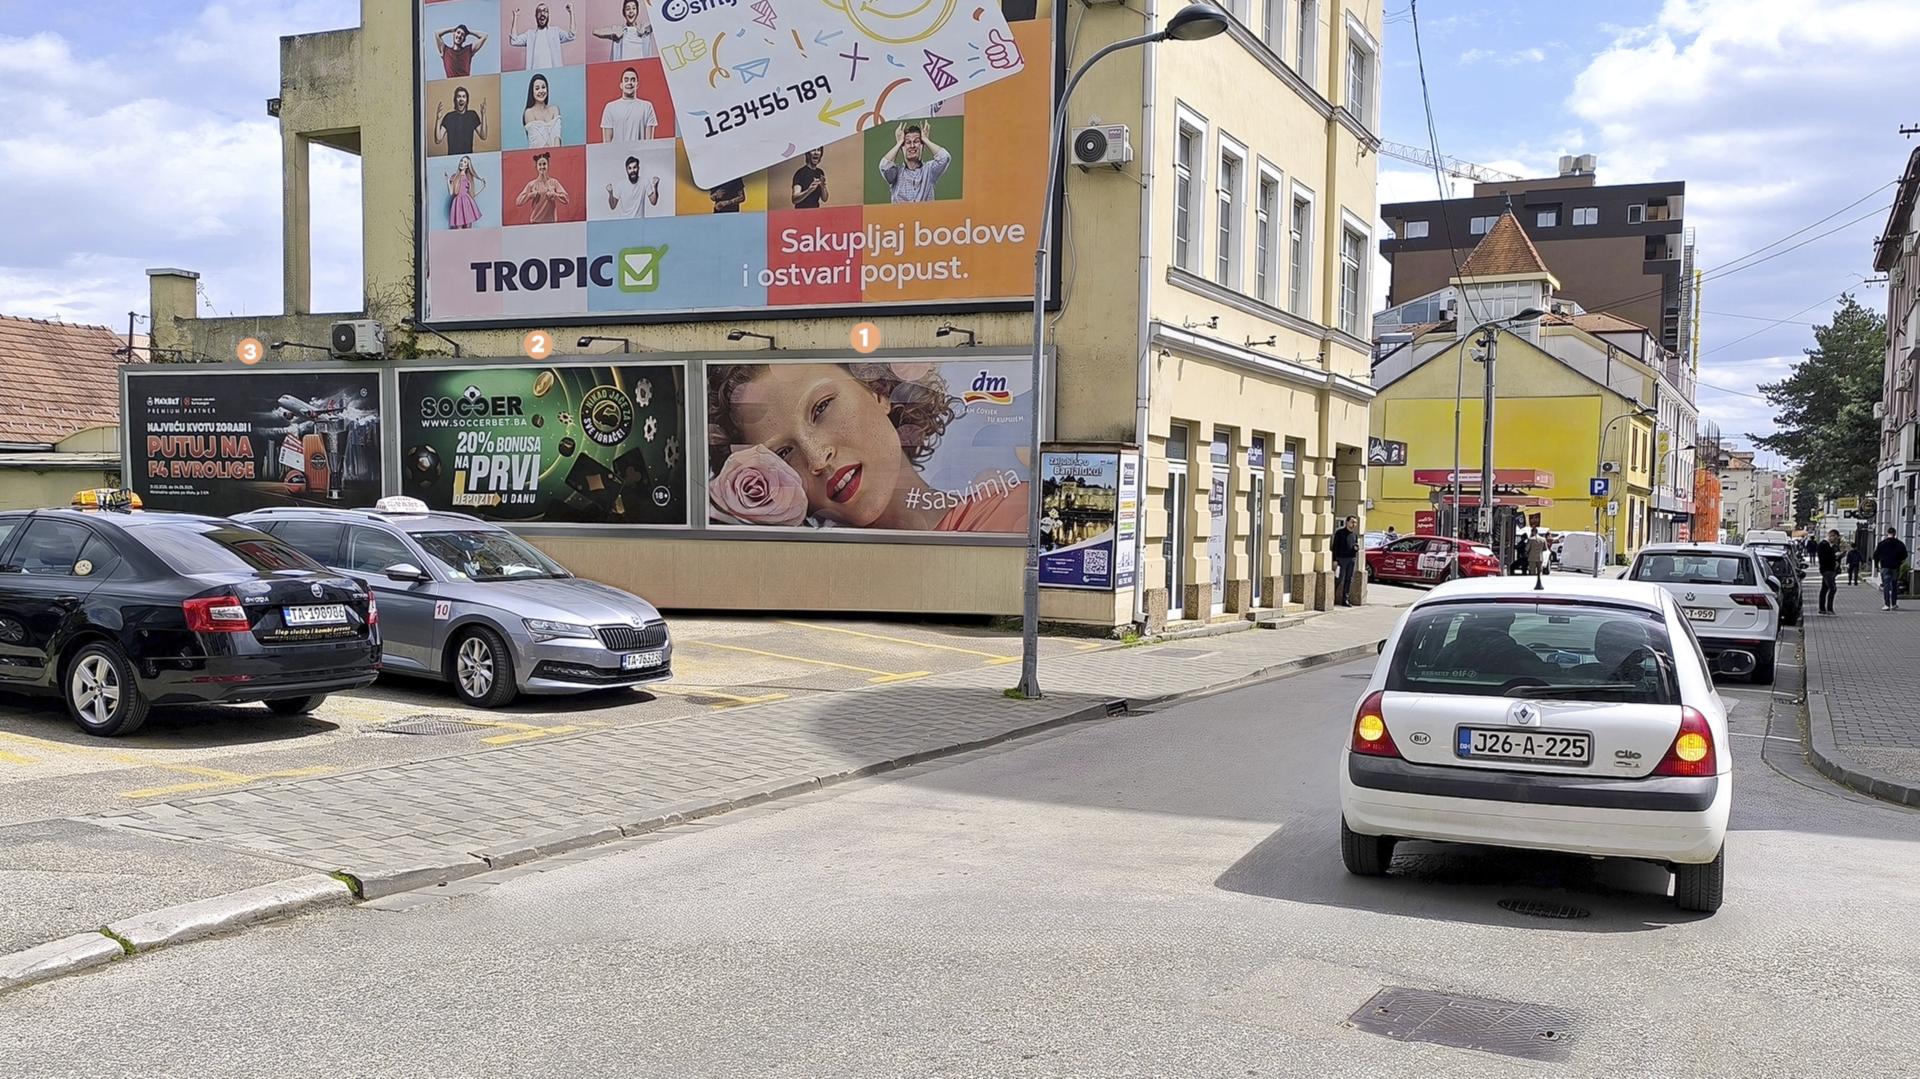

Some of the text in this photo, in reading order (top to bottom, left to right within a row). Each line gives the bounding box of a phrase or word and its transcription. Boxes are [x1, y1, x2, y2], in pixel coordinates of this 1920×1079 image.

[781, 219, 1026, 257] Sakupljaj bodove
[470, 255, 614, 292] TROPIC
[742, 256, 969, 290] i ostvari popust.
[972, 371, 1007, 391] dm
[421, 395, 524, 418] SOCCER
[147, 420, 185, 432] NAJVEĆU
[187, 422, 215, 432] KVOTU
[216, 422, 247, 432] ZGRABI
[421, 418, 527, 428] WWW.SOCCERBET.BA
[147, 435, 254, 458] PUTUJ NA
[456, 431, 541, 453] 20% BONUSA
[148, 460, 255, 479] F4 EVROLIGE
[454, 454, 541, 491] NA PRVI
[905, 469, 1022, 510] #sasvimja
[1594, 480, 1605, 494] P
[453, 493, 536, 505] DEPOZIT U DANU
[437, 604, 449, 616] 10
[1685, 609, 1714, 618] -T-959
[1473, 732, 1586, 758] J26-A-225
[1615, 749, 1642, 759] Clio
